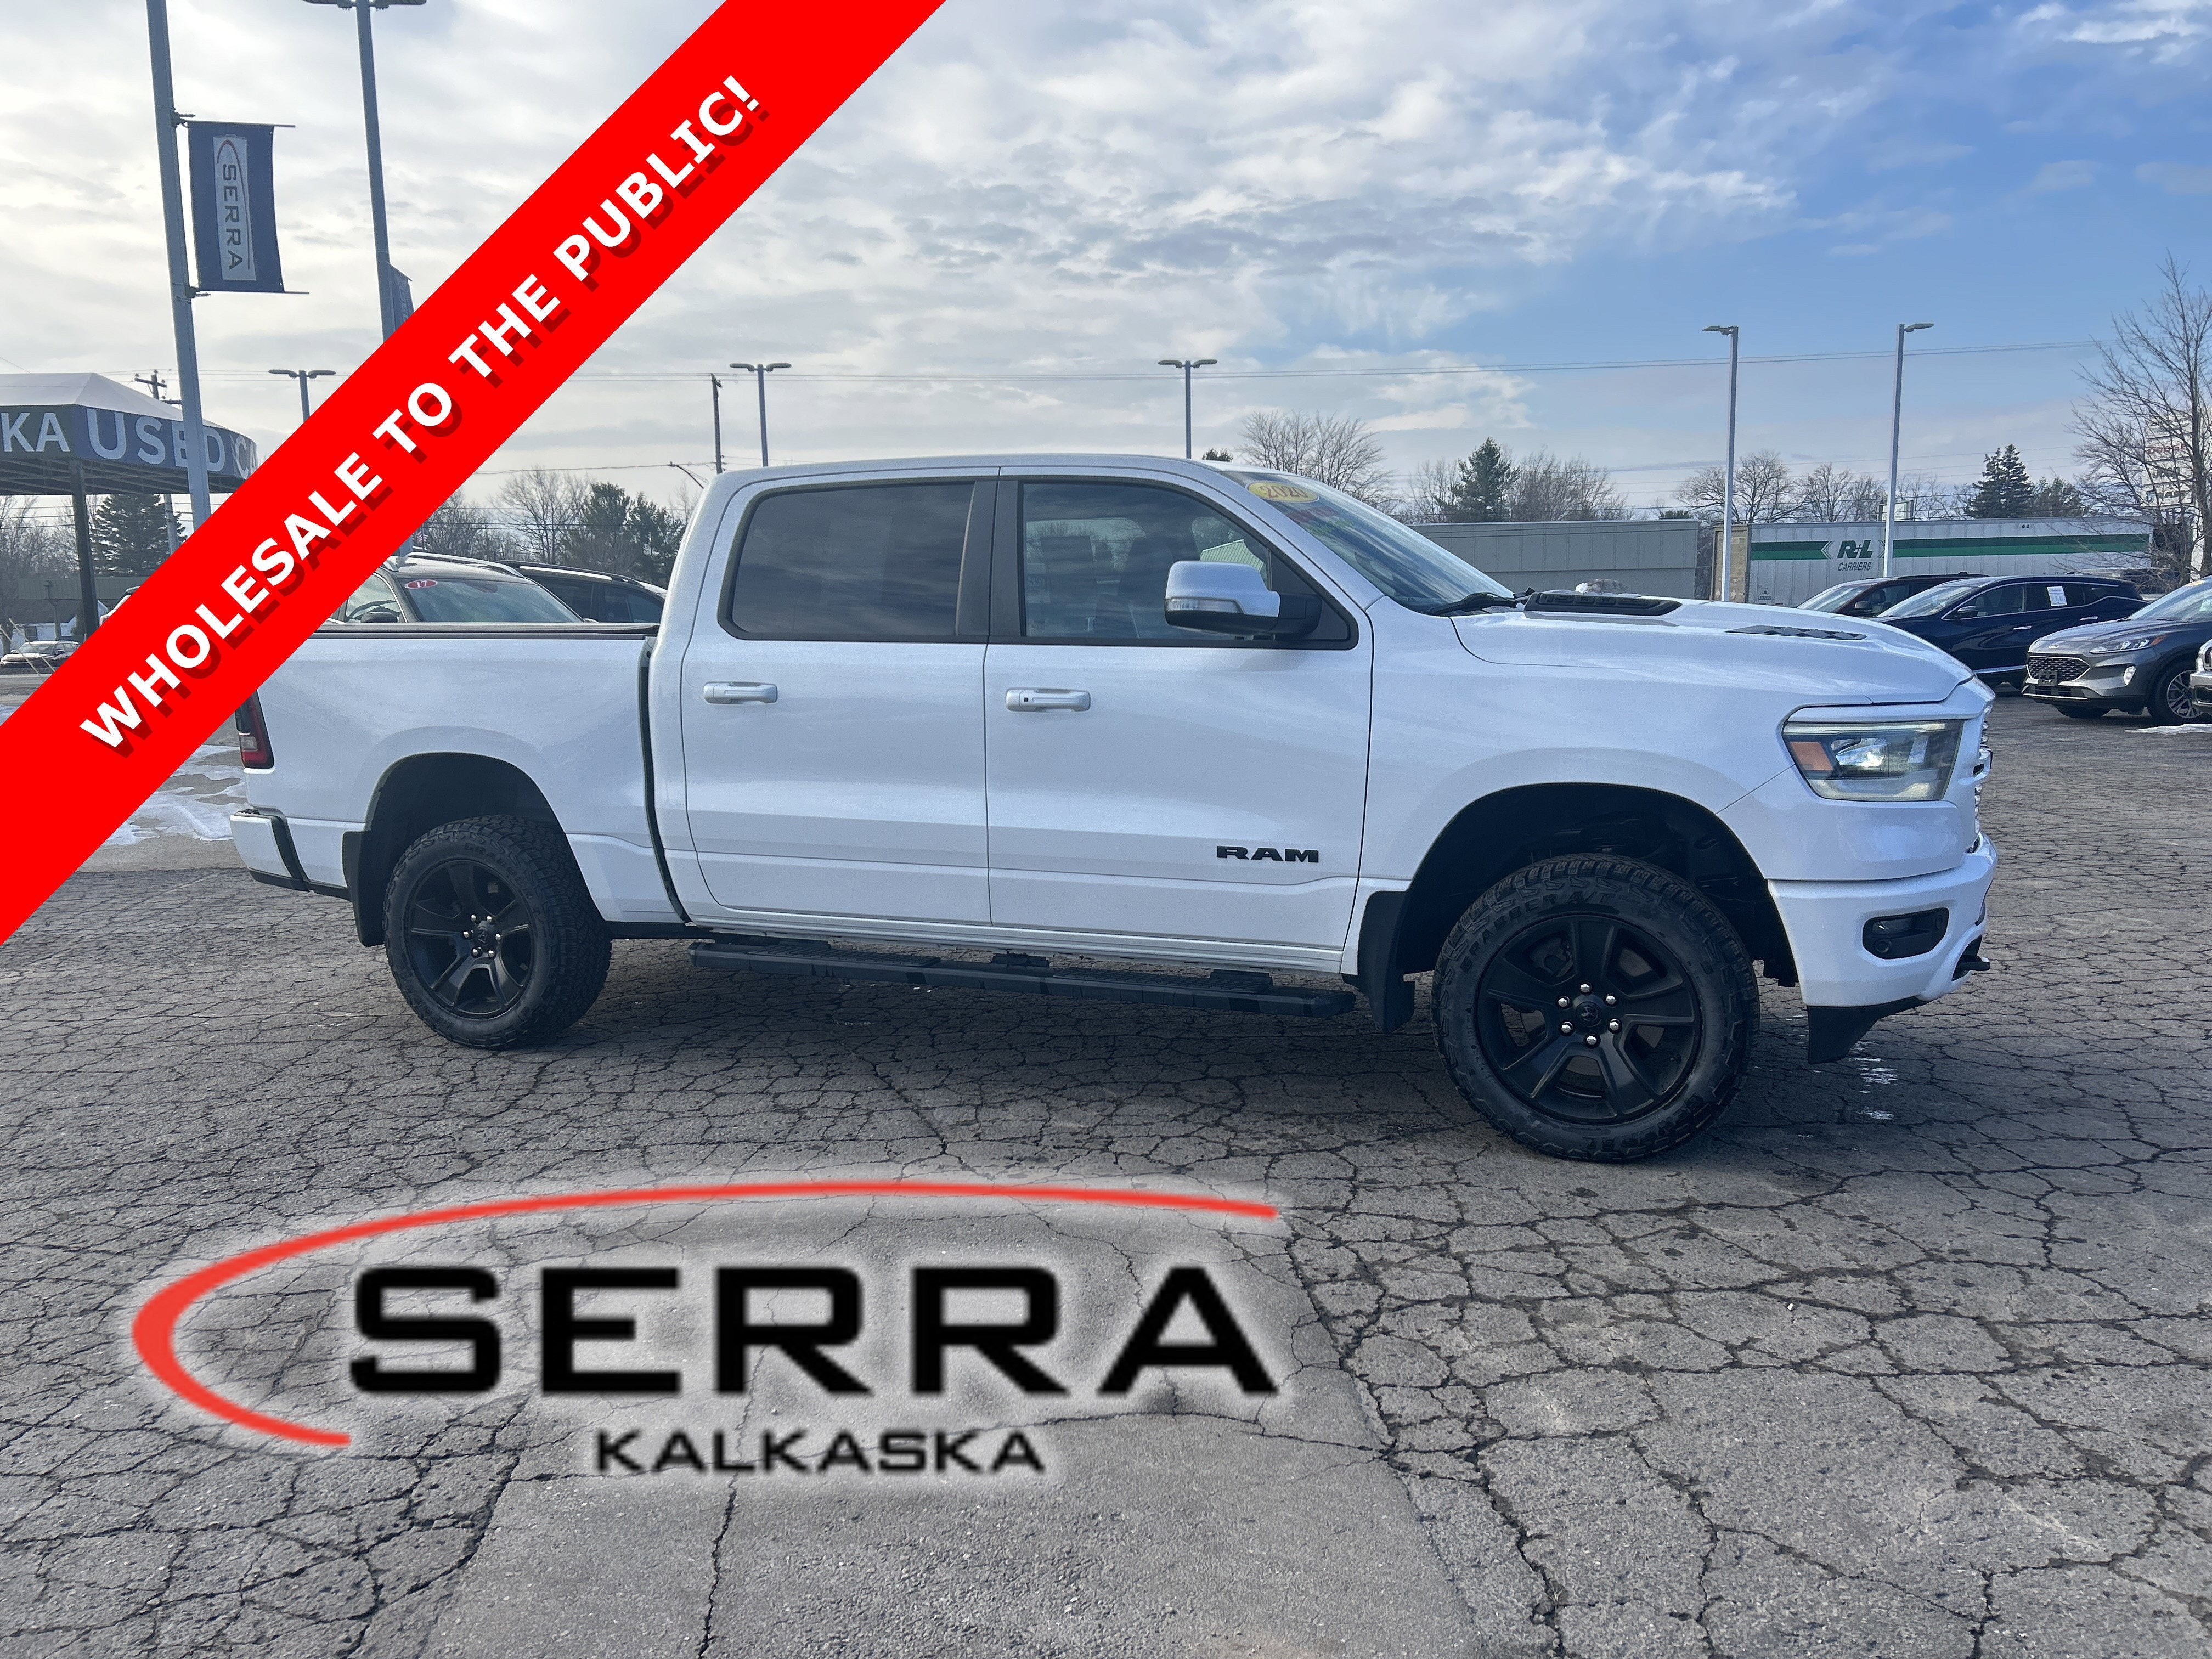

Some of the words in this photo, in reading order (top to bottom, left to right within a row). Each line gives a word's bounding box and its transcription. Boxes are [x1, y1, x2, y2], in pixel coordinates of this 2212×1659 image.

[222, 164, 242, 270] SERRA
[1260, 486, 1308, 498] 2020
[1838, 562, 1872, 571] CARRIERS
[1216, 845, 1319, 863] RAM
[1460, 893, 1558, 973] GRABBER
